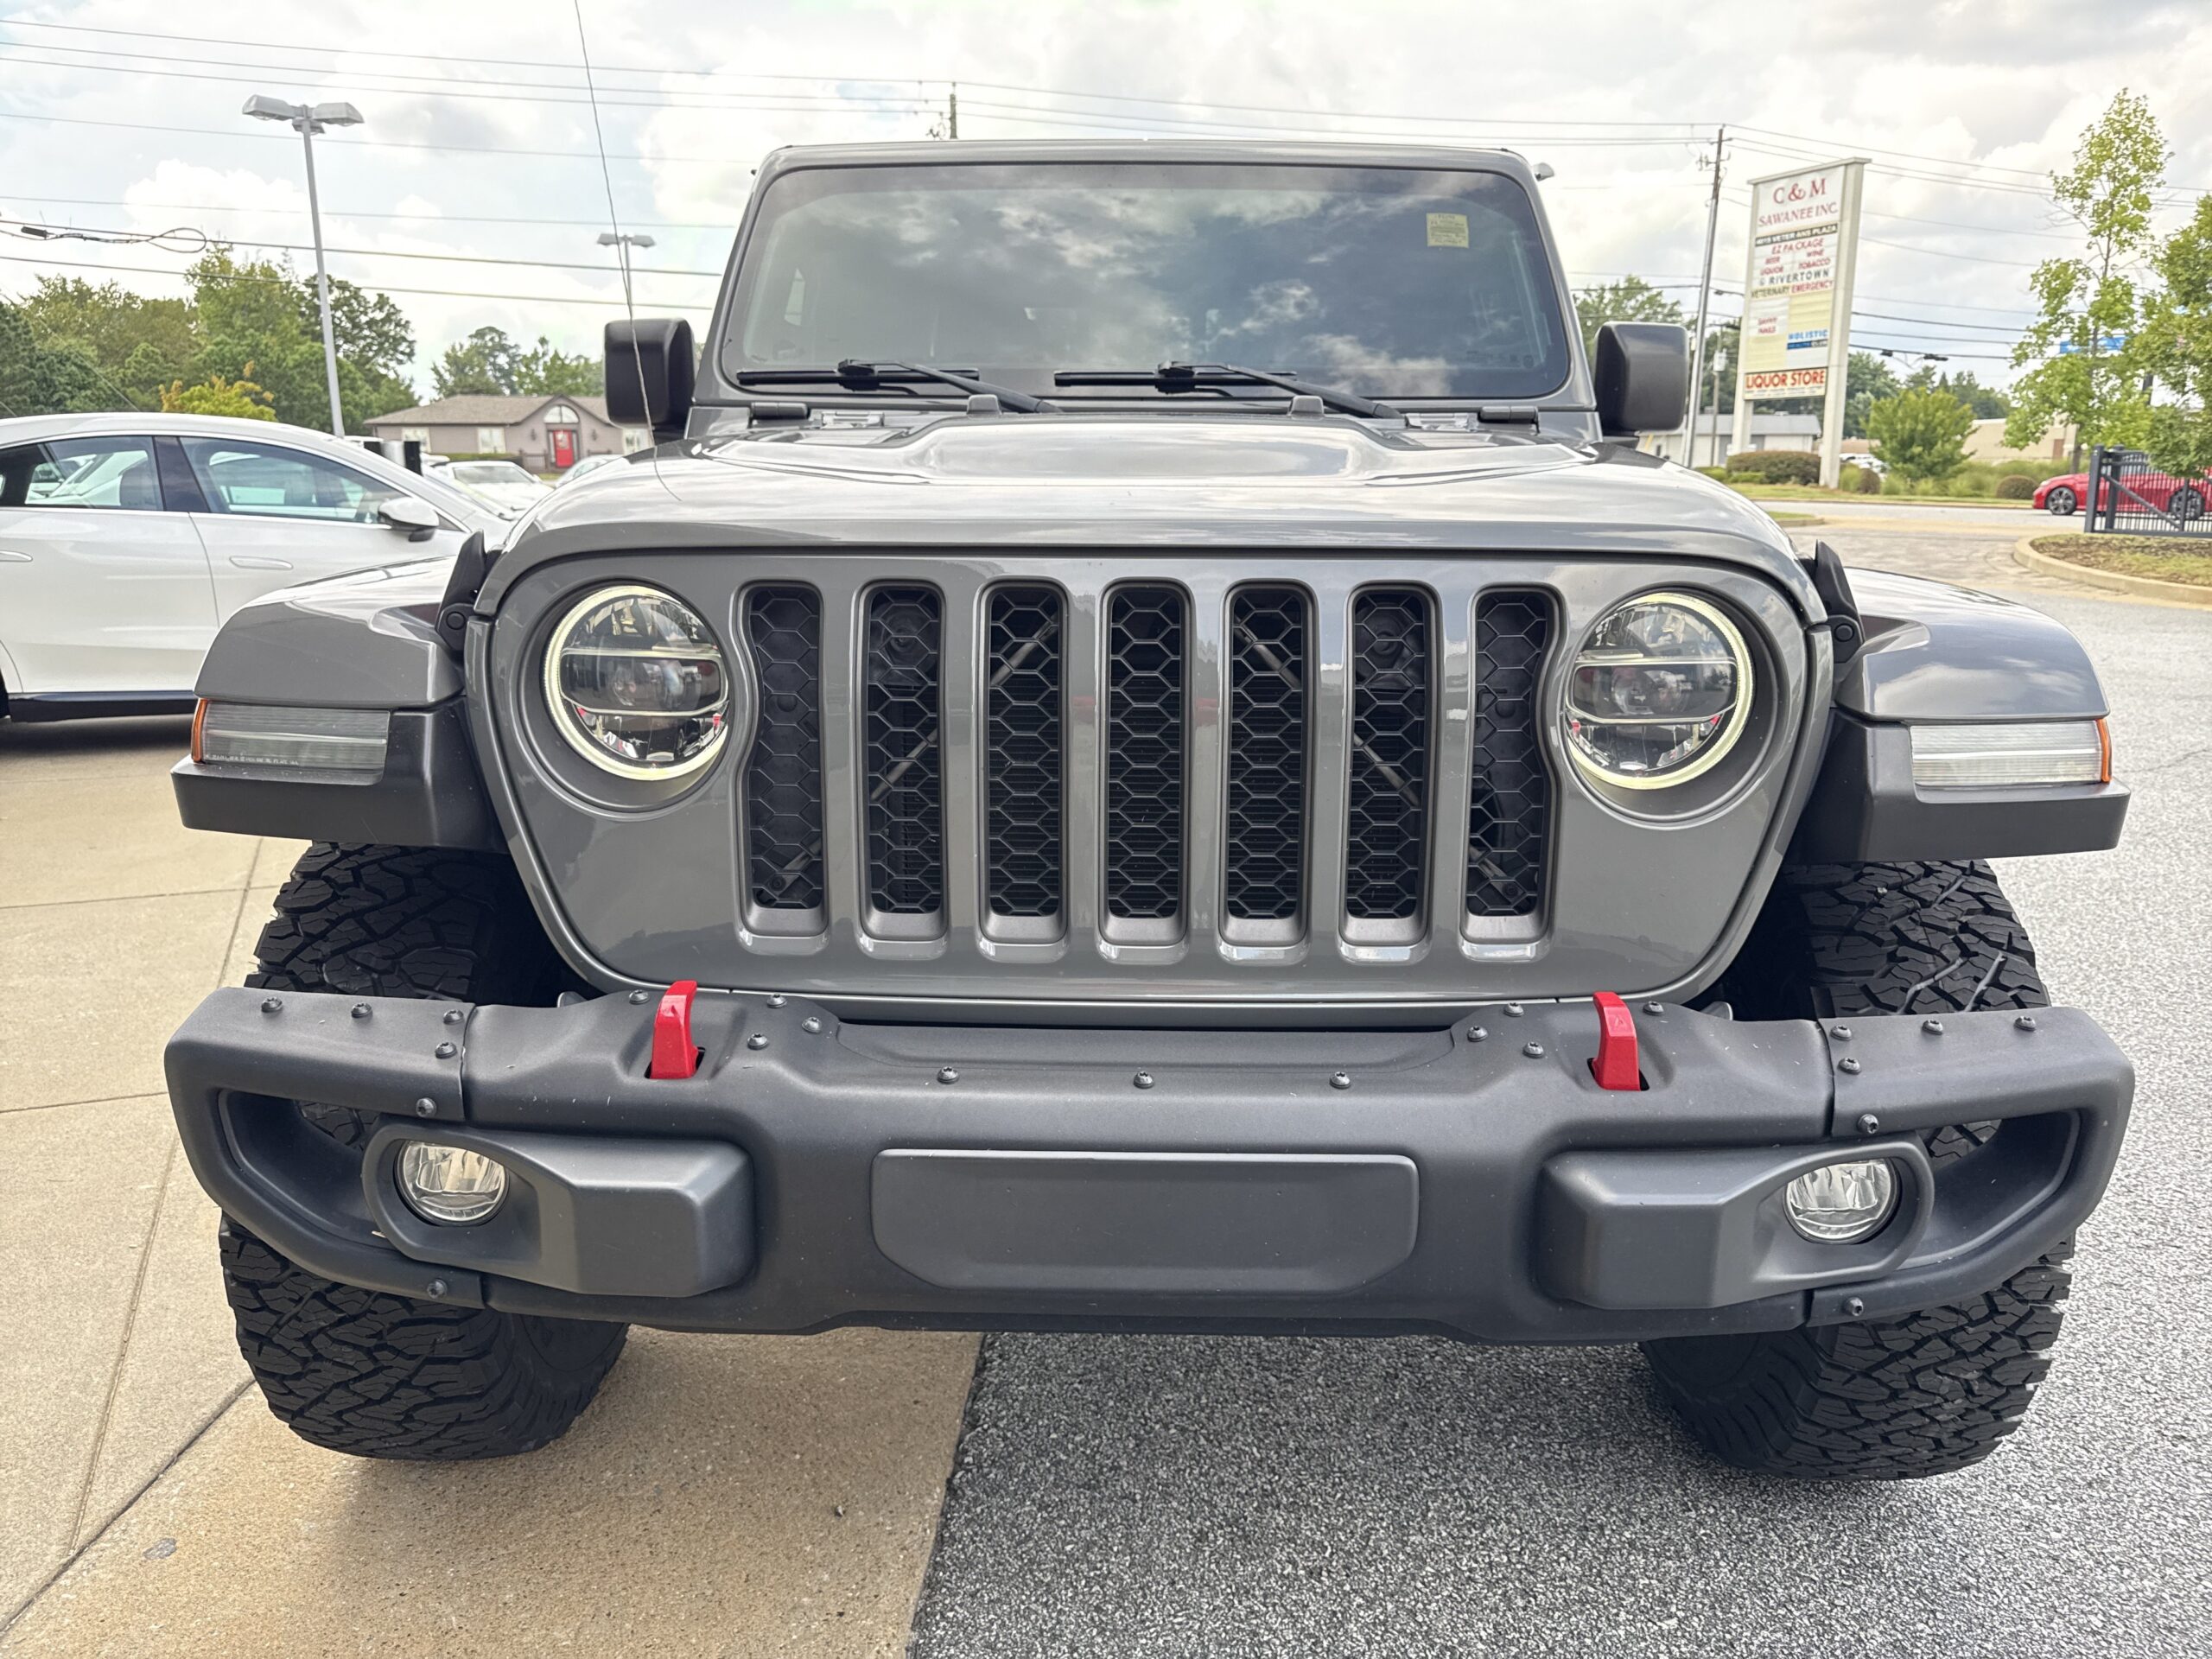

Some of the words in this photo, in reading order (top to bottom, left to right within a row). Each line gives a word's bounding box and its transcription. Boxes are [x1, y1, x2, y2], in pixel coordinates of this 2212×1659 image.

[1773, 187, 1785, 204] C
[1788, 183, 1806, 201] &
[1808, 178, 1827, 199] M
[1758, 207, 1814, 227] SAWANEE
[1815, 201, 1839, 217] INC
[1760, 266, 1784, 276] LIQUOR
[1798, 257, 1831, 270] TOBACCO
[1769, 268, 1830, 285] RIVERTOWN
[1791, 279, 1834, 294] EMERGENCY
[1745, 373, 1788, 389] LIQUOR
[1790, 370, 1825, 386] STORE
